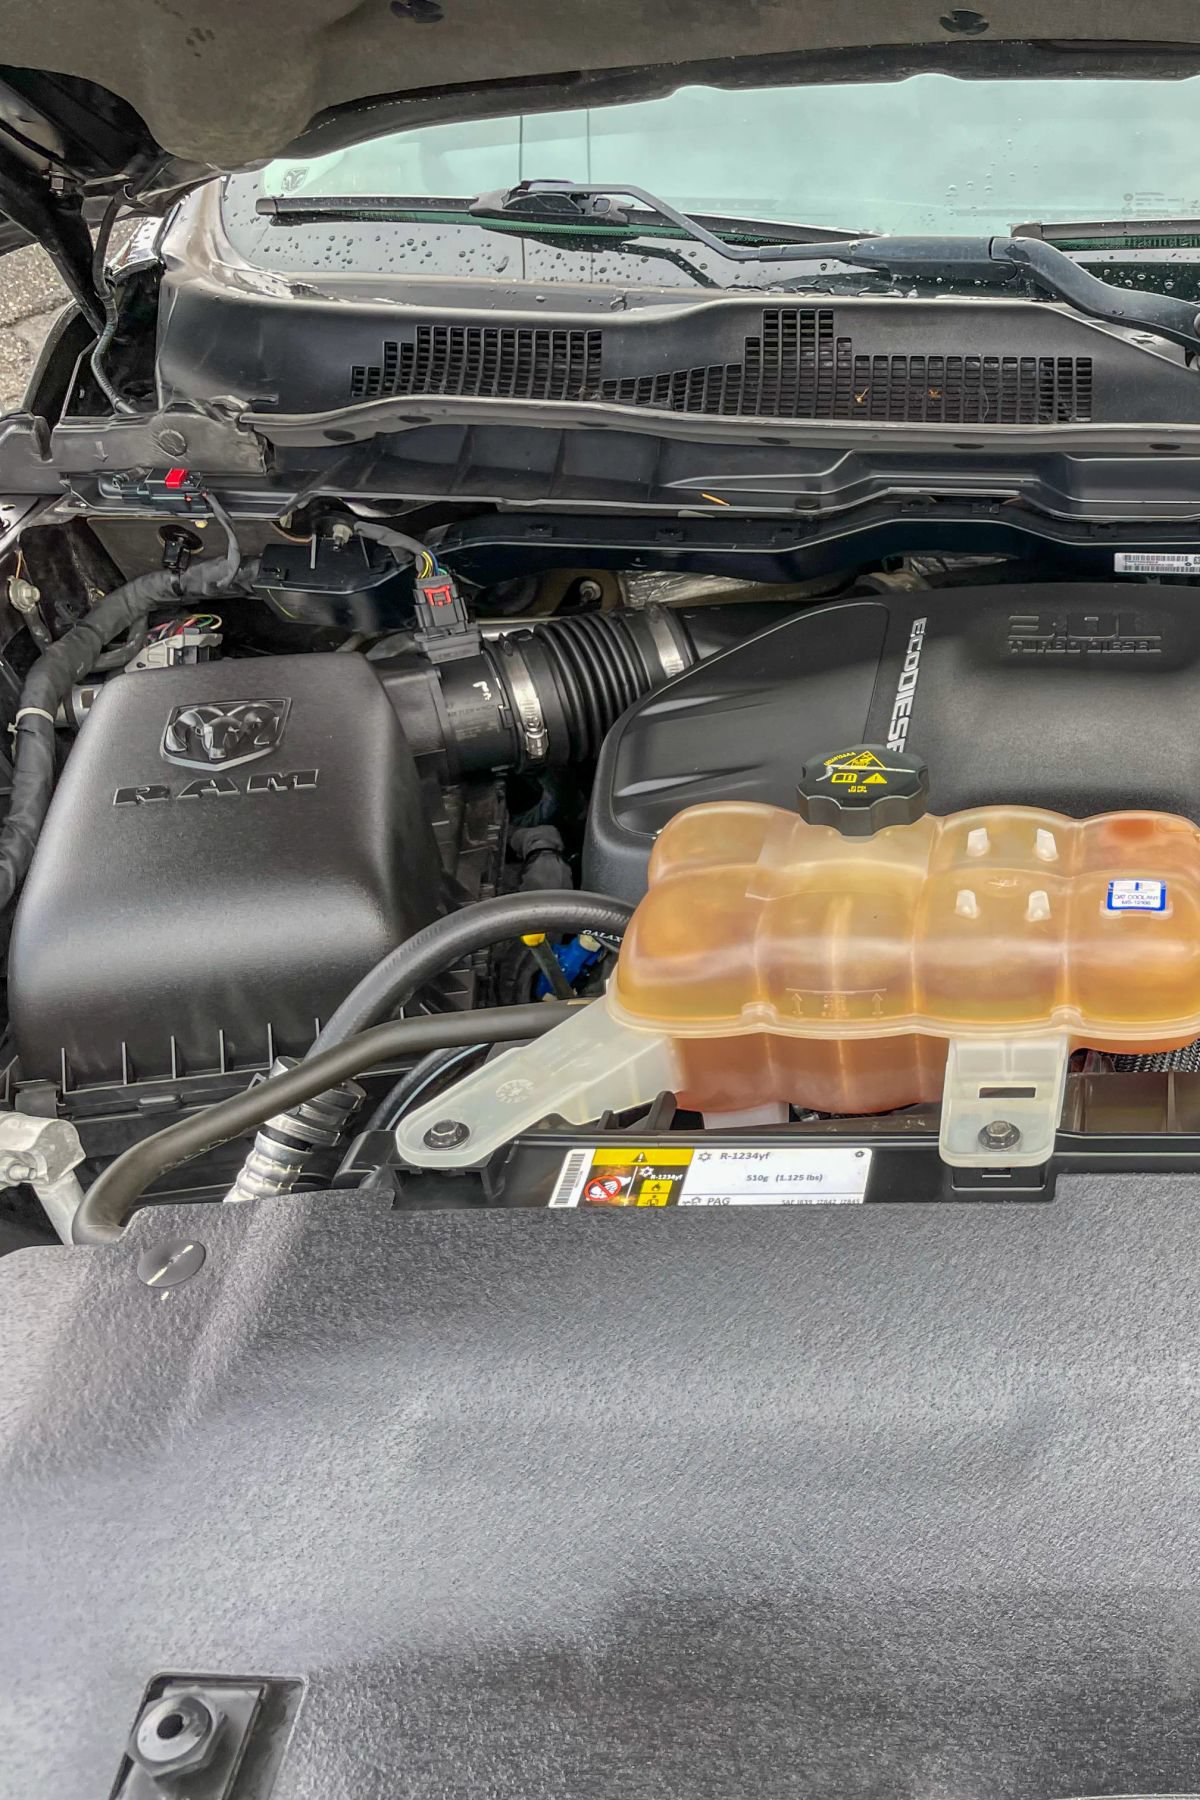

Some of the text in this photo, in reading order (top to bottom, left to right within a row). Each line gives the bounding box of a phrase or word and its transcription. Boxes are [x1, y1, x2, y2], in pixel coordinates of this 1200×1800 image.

[886, 617, 927, 753] ECODIESE
[112, 768, 320, 807] RAM
[719, 1151, 770, 1162] R-1234yf
[746, 1173, 823, 1183] 510g (1.125 lbs)
[707, 1197, 731, 1206] PAG
